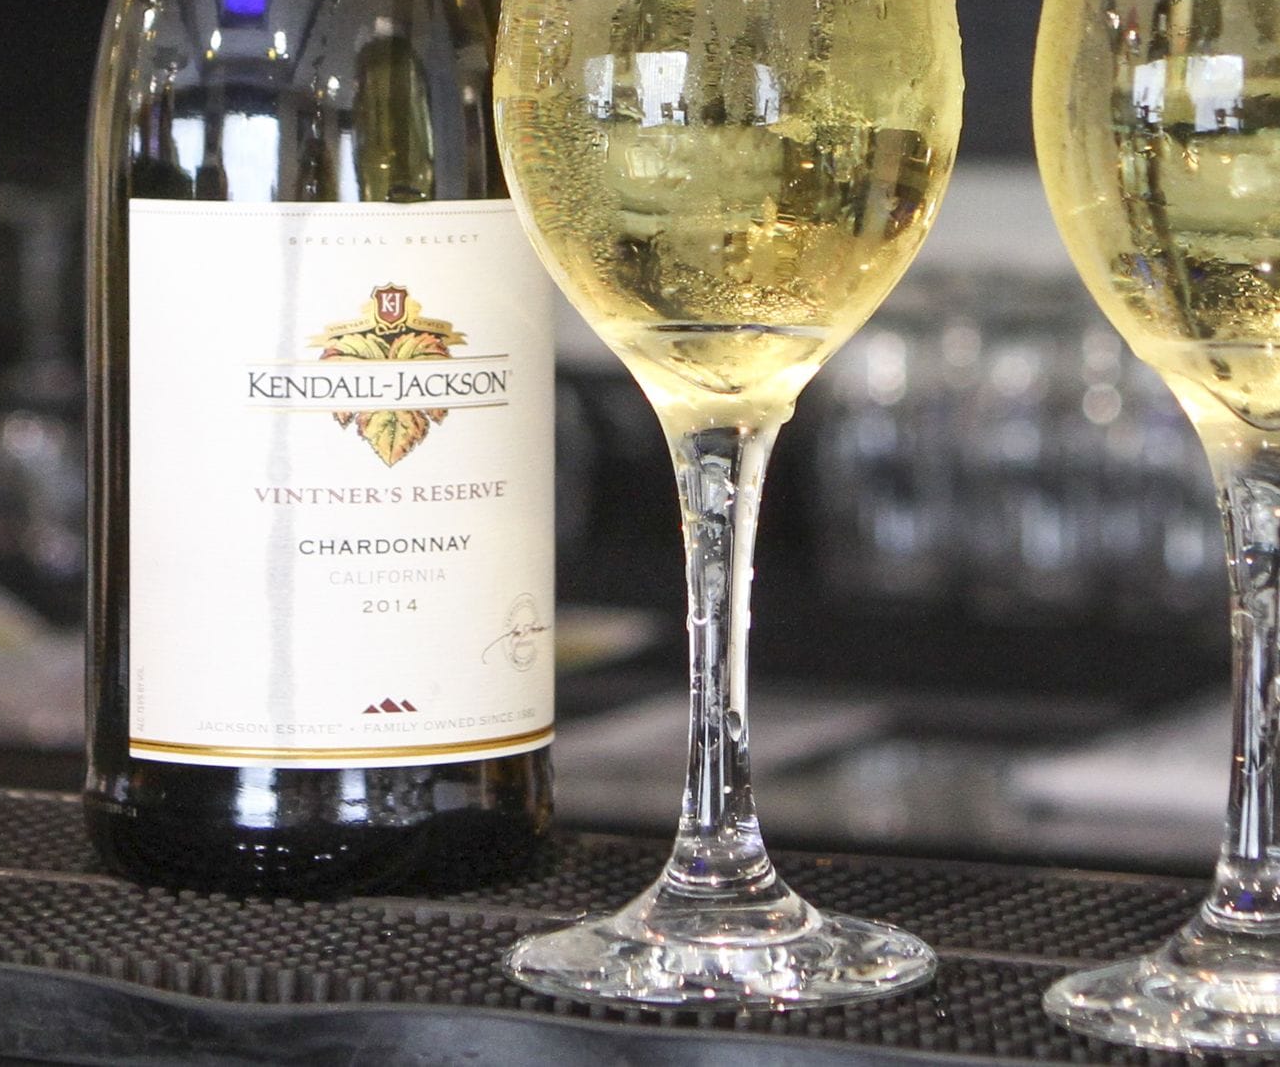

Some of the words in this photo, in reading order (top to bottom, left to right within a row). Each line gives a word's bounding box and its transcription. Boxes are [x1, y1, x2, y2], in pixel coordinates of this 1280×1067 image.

[289, 236, 387, 246] SPECIAL
[405, 233, 480, 245] SELECT
[380, 292, 400, 316] K-J
[254, 486, 402, 504] VINTNER'S
[413, 481, 507, 502] RESERVE
[299, 535, 471, 555] CHARDONNAY
[329, 568, 446, 585] CALIFORNIA
[362, 599, 418, 613] 2014
[196, 720, 269, 734] JACKSON
[364, 721, 418, 733] FAMILY
[423, 717, 476, 731] OWNED
